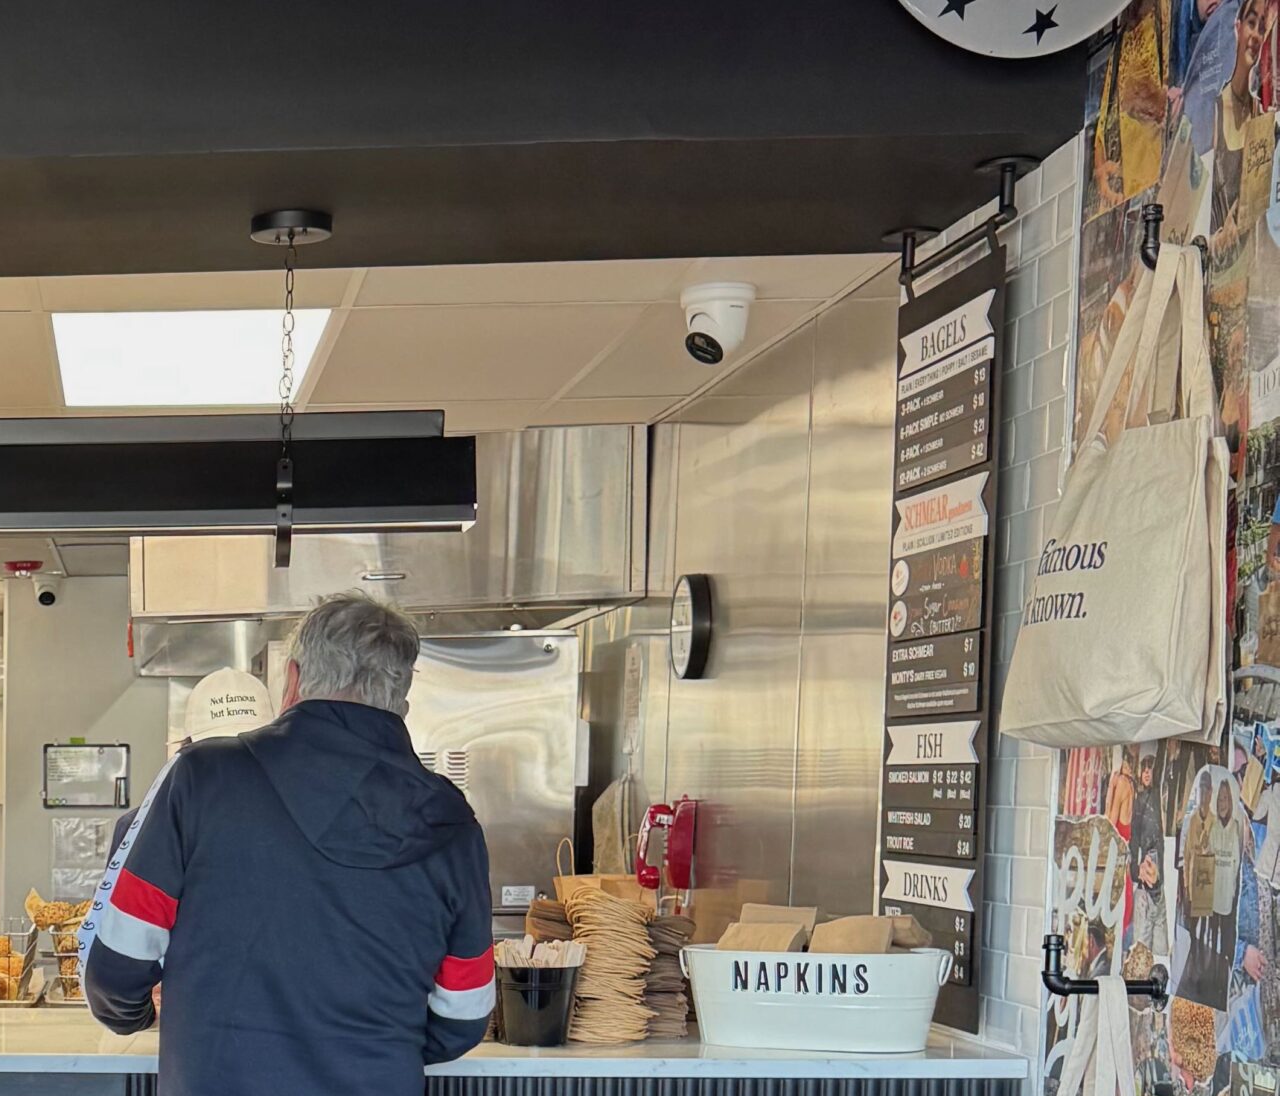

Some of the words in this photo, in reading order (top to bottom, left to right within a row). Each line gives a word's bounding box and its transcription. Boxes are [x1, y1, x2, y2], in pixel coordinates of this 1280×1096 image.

[920, 314, 966, 361] BAGELS
[901, 384, 913, 394] PLAIN
[901, 397, 921, 416] 3-PACK
[920, 412, 939, 431] SIMPLE
[904, 494, 949, 531] SCHMEAR
[892, 649, 909, 662] EXTRA
[908, 644, 934, 660] SCHMEAR
[210, 697, 224, 706] Not
[226, 693, 256, 703] famous
[210, 709, 224, 720] but
[917, 733, 943, 759] FISH
[888, 771, 909, 783] SMOKED
[908, 771, 930, 783] SALMON
[888, 811, 914, 825] WHITEFISH
[913, 812, 931, 825] SALAD
[886, 836, 904, 849] TROUT
[903, 837, 915, 850] ROE
[904, 872, 949, 903] DRINKS
[732, 960, 869, 994] NAPKINS
